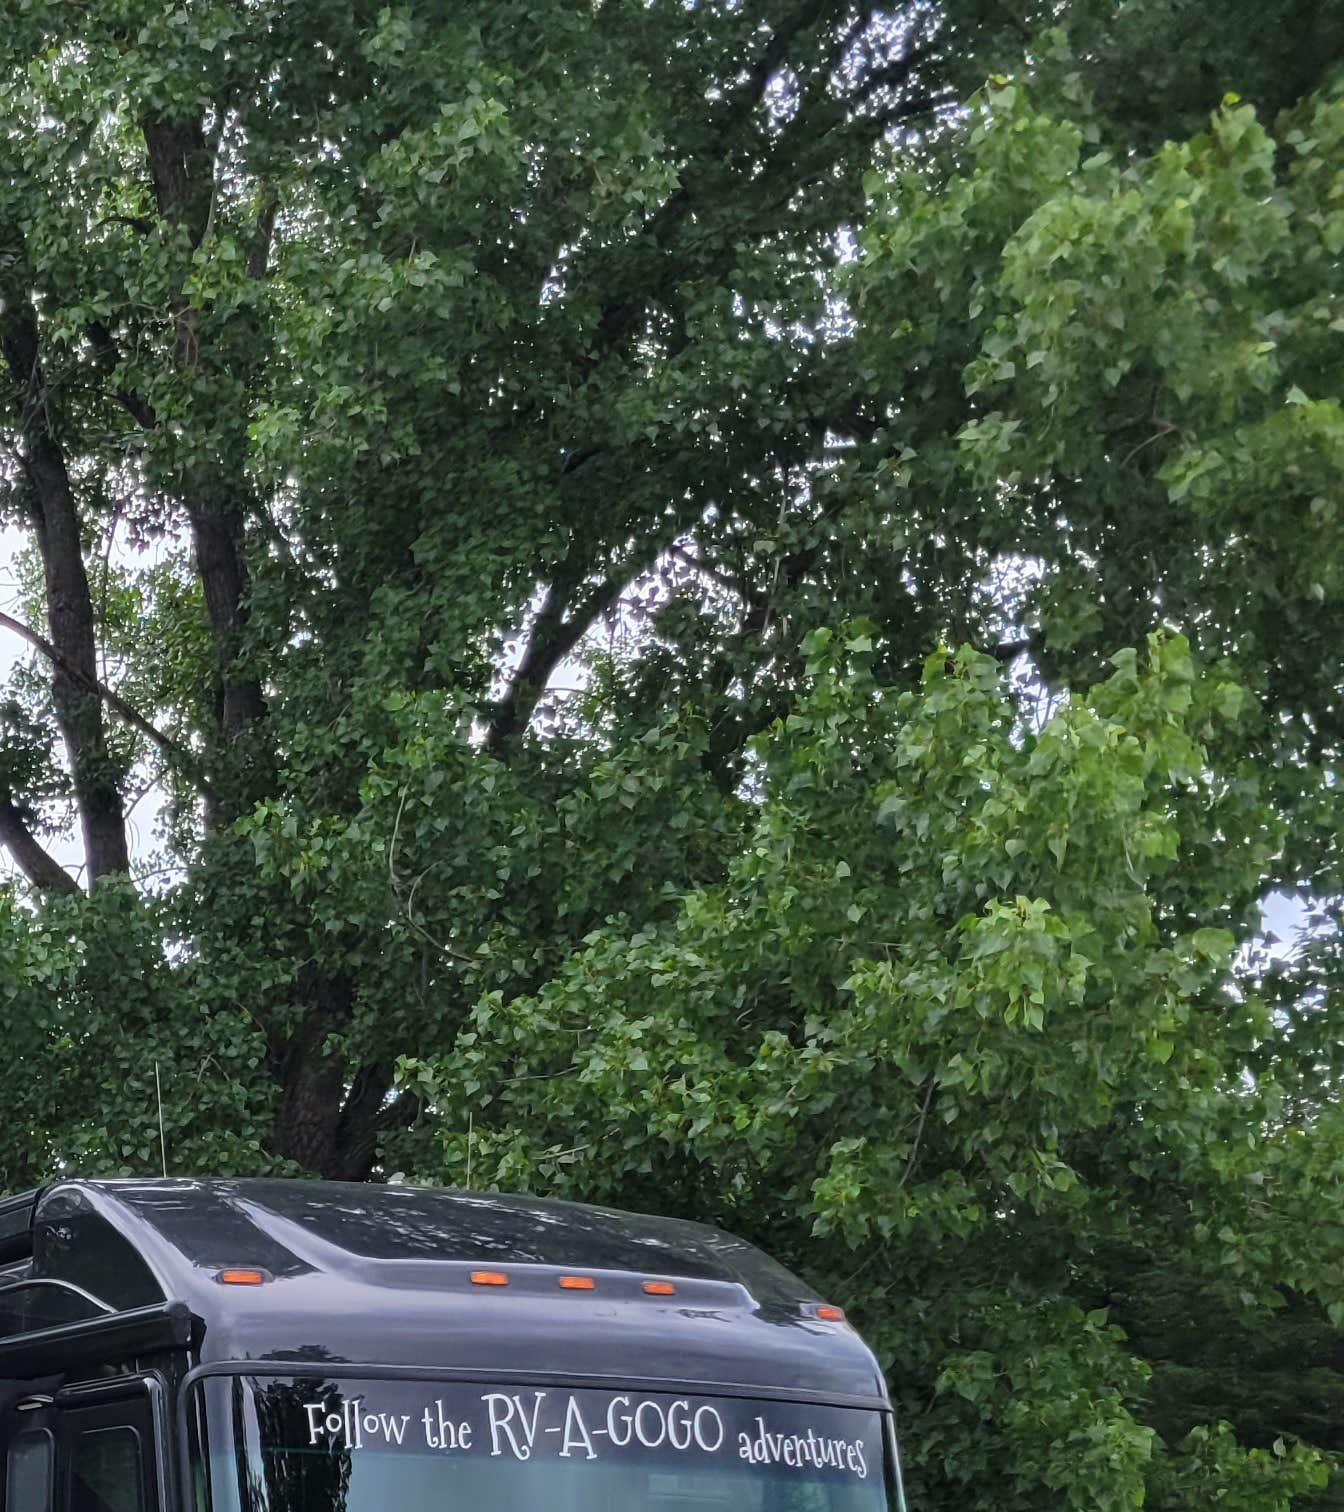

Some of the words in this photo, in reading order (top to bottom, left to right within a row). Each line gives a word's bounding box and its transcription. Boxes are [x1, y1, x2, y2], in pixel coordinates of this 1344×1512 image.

[302, 1399, 410, 1449] Follow
[421, 1399, 472, 1449] the
[480, 1391, 724, 1461] RV-A-GOGO
[738, 1416, 867, 1479] adventures
